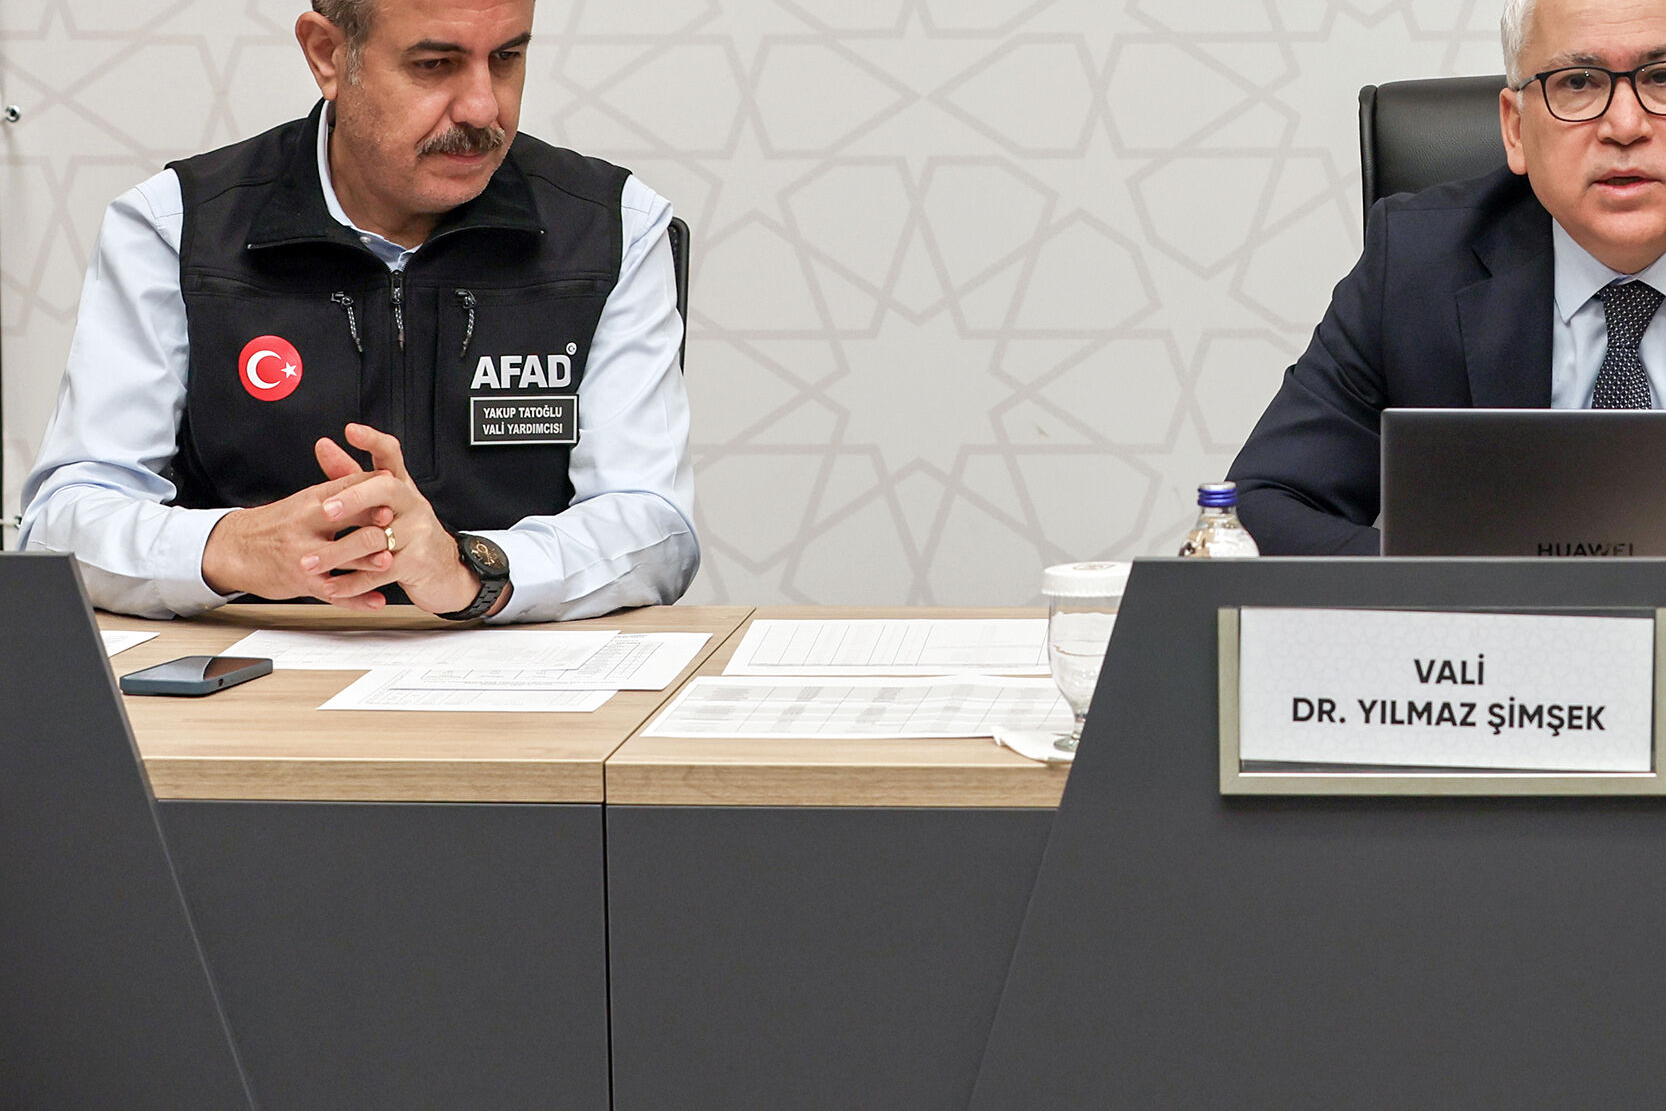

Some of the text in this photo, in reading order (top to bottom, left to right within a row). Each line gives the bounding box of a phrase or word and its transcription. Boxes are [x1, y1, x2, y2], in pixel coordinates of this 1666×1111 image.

[470, 354, 572, 389] AFAD
[483, 404, 563, 419] YAKUP TATOĞLU
[482, 421, 563, 435] VALİ YARDIMCISI
[1413, 653, 1485, 685] VALİ
[1292, 696, 1606, 737] DR. YILMAZ ŞİMŞEK
